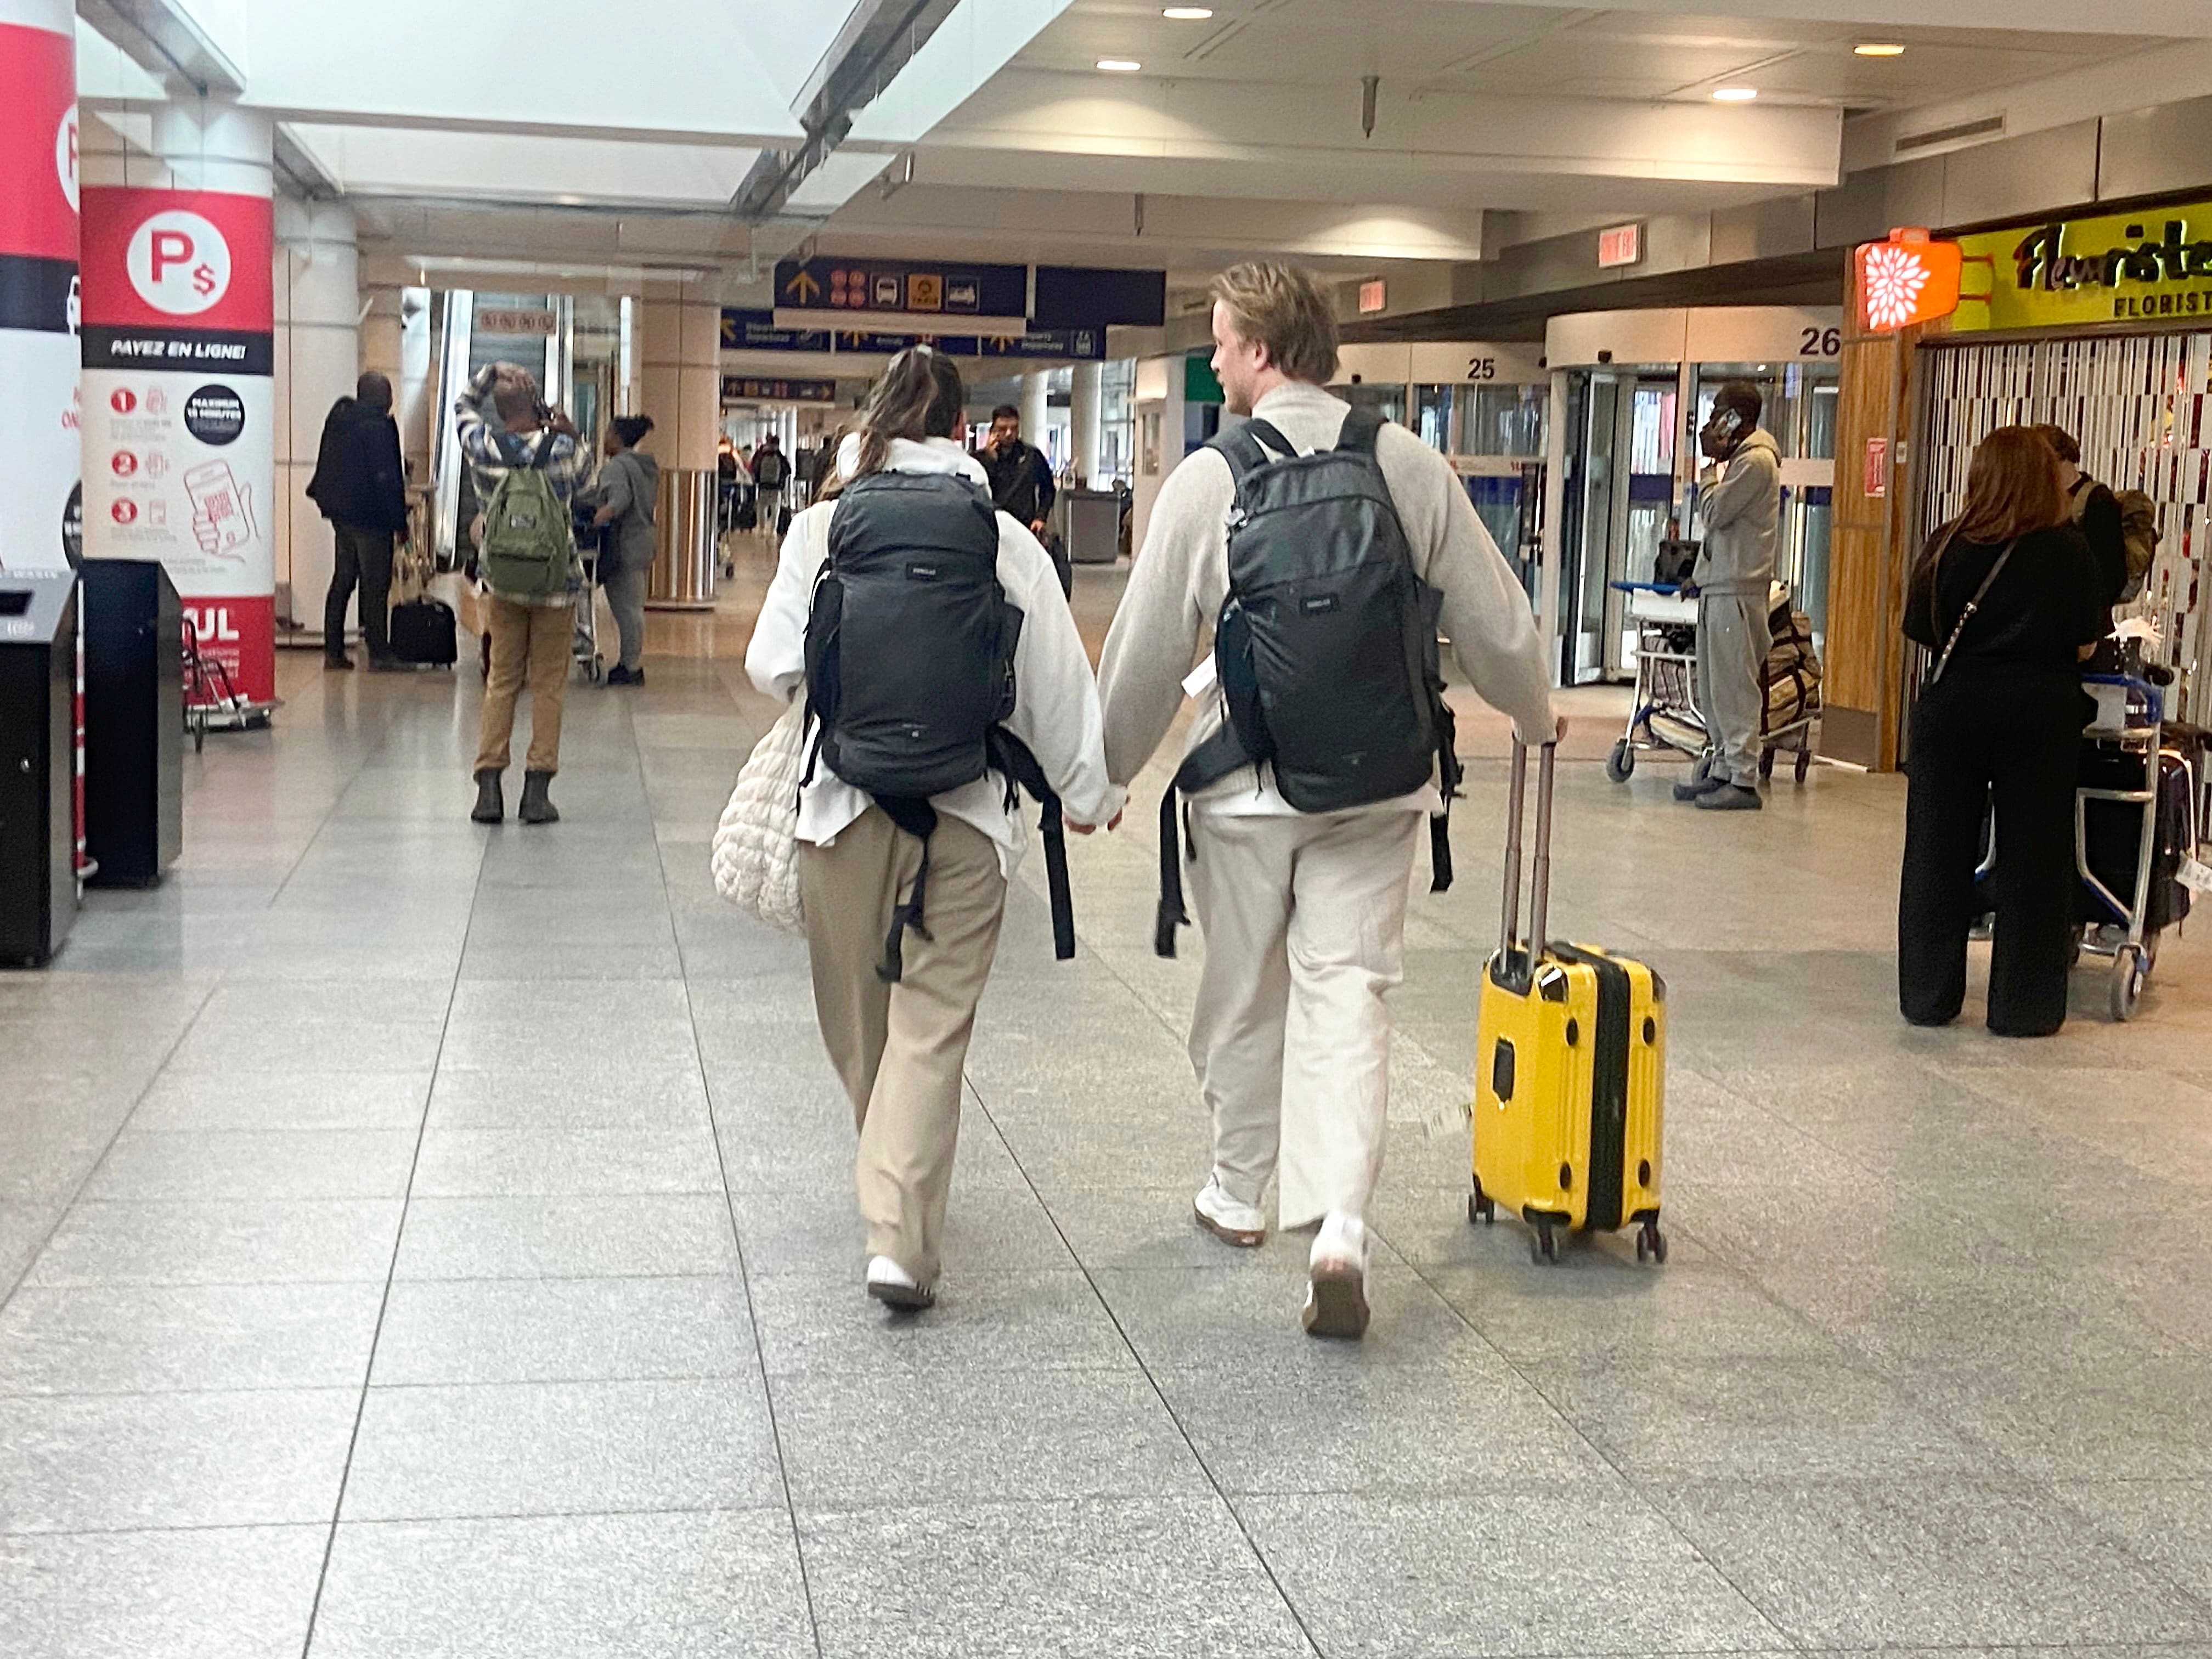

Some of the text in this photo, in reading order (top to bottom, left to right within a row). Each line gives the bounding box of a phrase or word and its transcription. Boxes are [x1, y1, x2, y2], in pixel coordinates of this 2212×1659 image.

[111, 339, 165, 357] PAYEZ
[167, 341, 193, 358] EN
[1799, 327, 1841, 356] 26
[1468, 358, 1496, 379] 25
[117, 391, 127, 411] 1
[117, 455, 131, 474] 2
[118, 500, 132, 522] 3
